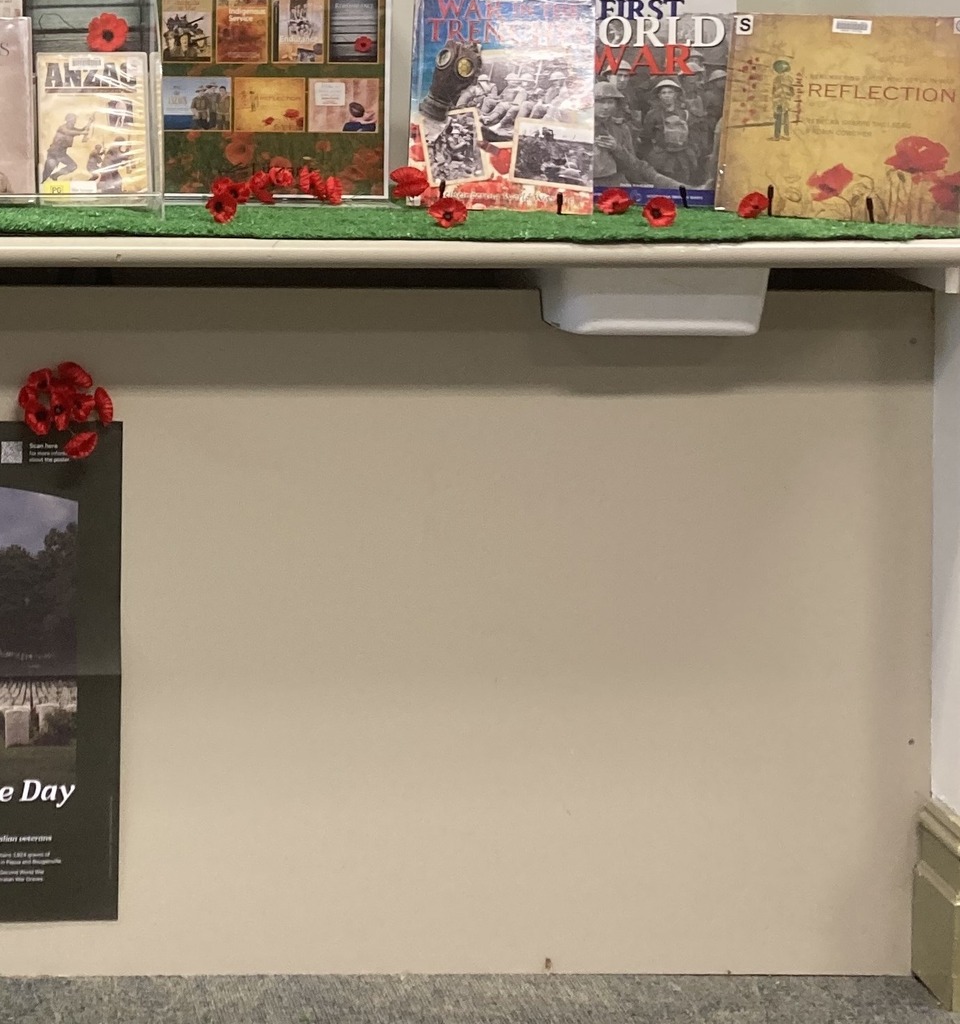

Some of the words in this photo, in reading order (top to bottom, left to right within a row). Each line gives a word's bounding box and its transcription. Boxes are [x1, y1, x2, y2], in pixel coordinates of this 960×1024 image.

[598, 16, 726, 48] ORLD
[740, 18, 752, 32] S
[594, 44, 695, 76] WAR
[808, 82, 956, 104] REFLECTION
[19, 779, 76, 808] Day
